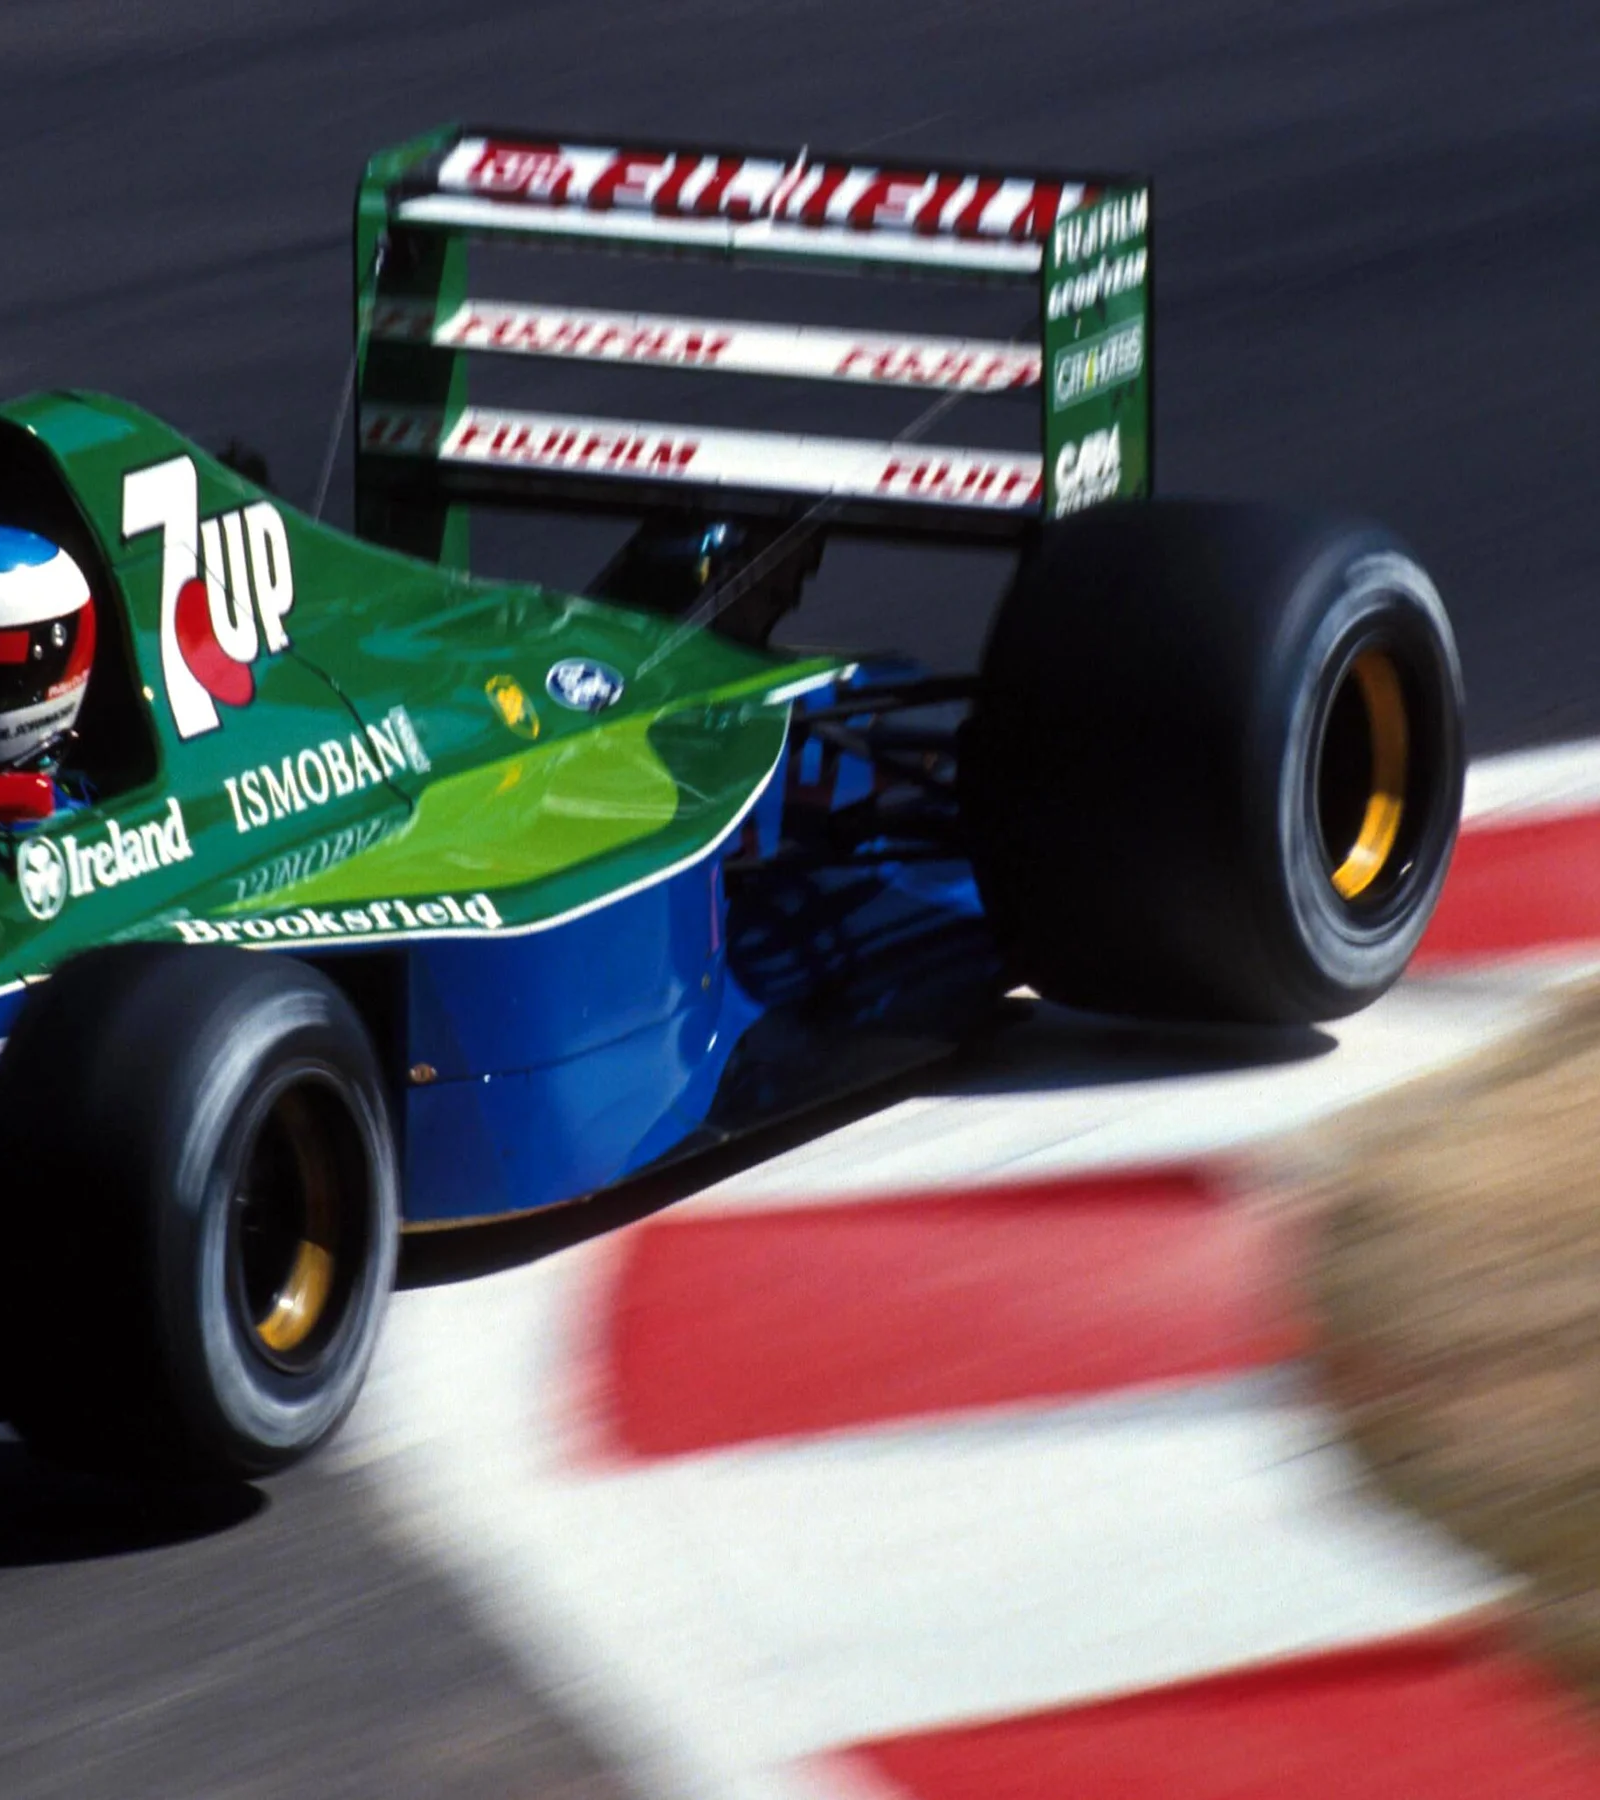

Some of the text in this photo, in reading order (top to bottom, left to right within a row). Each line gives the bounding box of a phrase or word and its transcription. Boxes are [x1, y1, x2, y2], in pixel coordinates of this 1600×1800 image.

[1053, 187, 1148, 269] FUJIFILM
[451, 312, 734, 363] FUJIFILM
[453, 422, 700, 476] FUJIFILM
[61, 796, 194, 898] Ireland
[173, 893, 503, 939] Brooksfield
